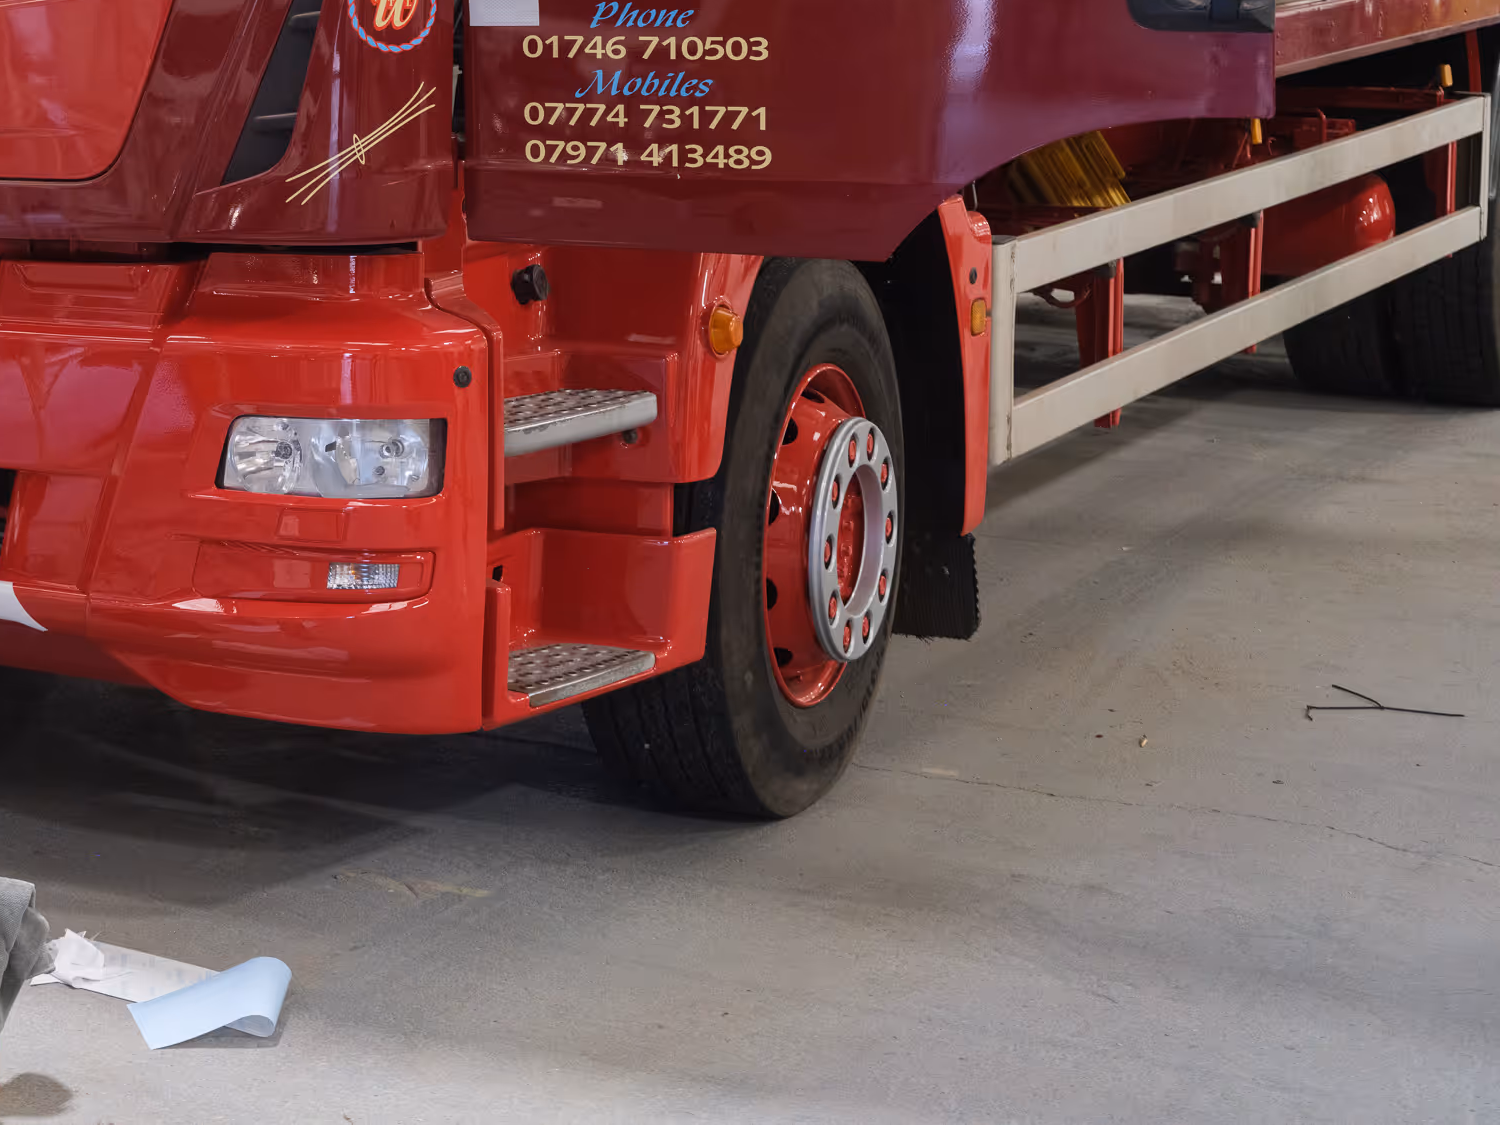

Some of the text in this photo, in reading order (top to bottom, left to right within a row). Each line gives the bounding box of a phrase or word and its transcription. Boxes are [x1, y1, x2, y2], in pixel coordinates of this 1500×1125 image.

[590, 0, 695, 30] Phone
[522, 35, 770, 62] 01746 710503
[574, 69, 714, 98] Mobiles
[523, 102, 768, 131] 07774 731771
[524, 139, 773, 169] 07971 413489
